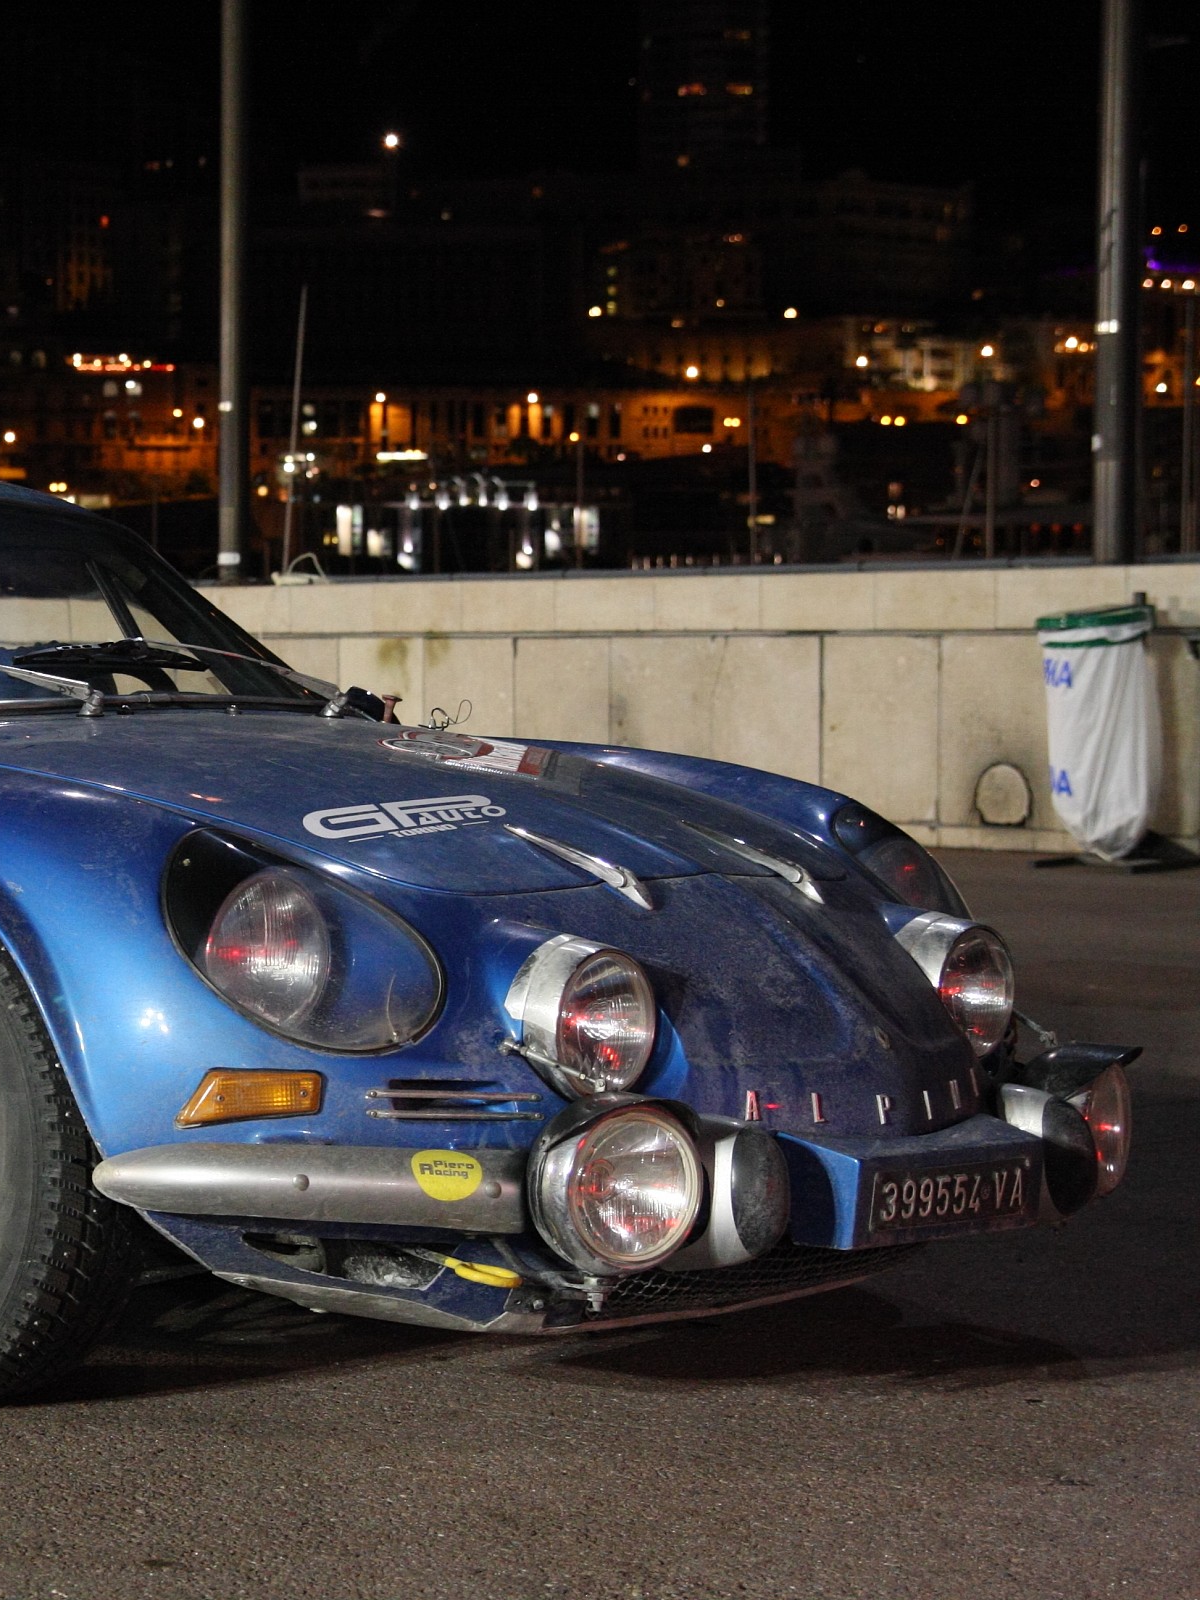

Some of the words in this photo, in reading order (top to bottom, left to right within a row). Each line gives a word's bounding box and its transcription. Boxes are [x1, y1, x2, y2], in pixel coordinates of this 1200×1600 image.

[302, 795, 492, 839] GP
[388, 823, 458, 838] TORINO
[418, 1163, 469, 1179] Racing
[433, 1160, 475, 1170] Piero
[880, 1173, 982, 1222] 399554
[994, 1167, 1024, 1210] VA
